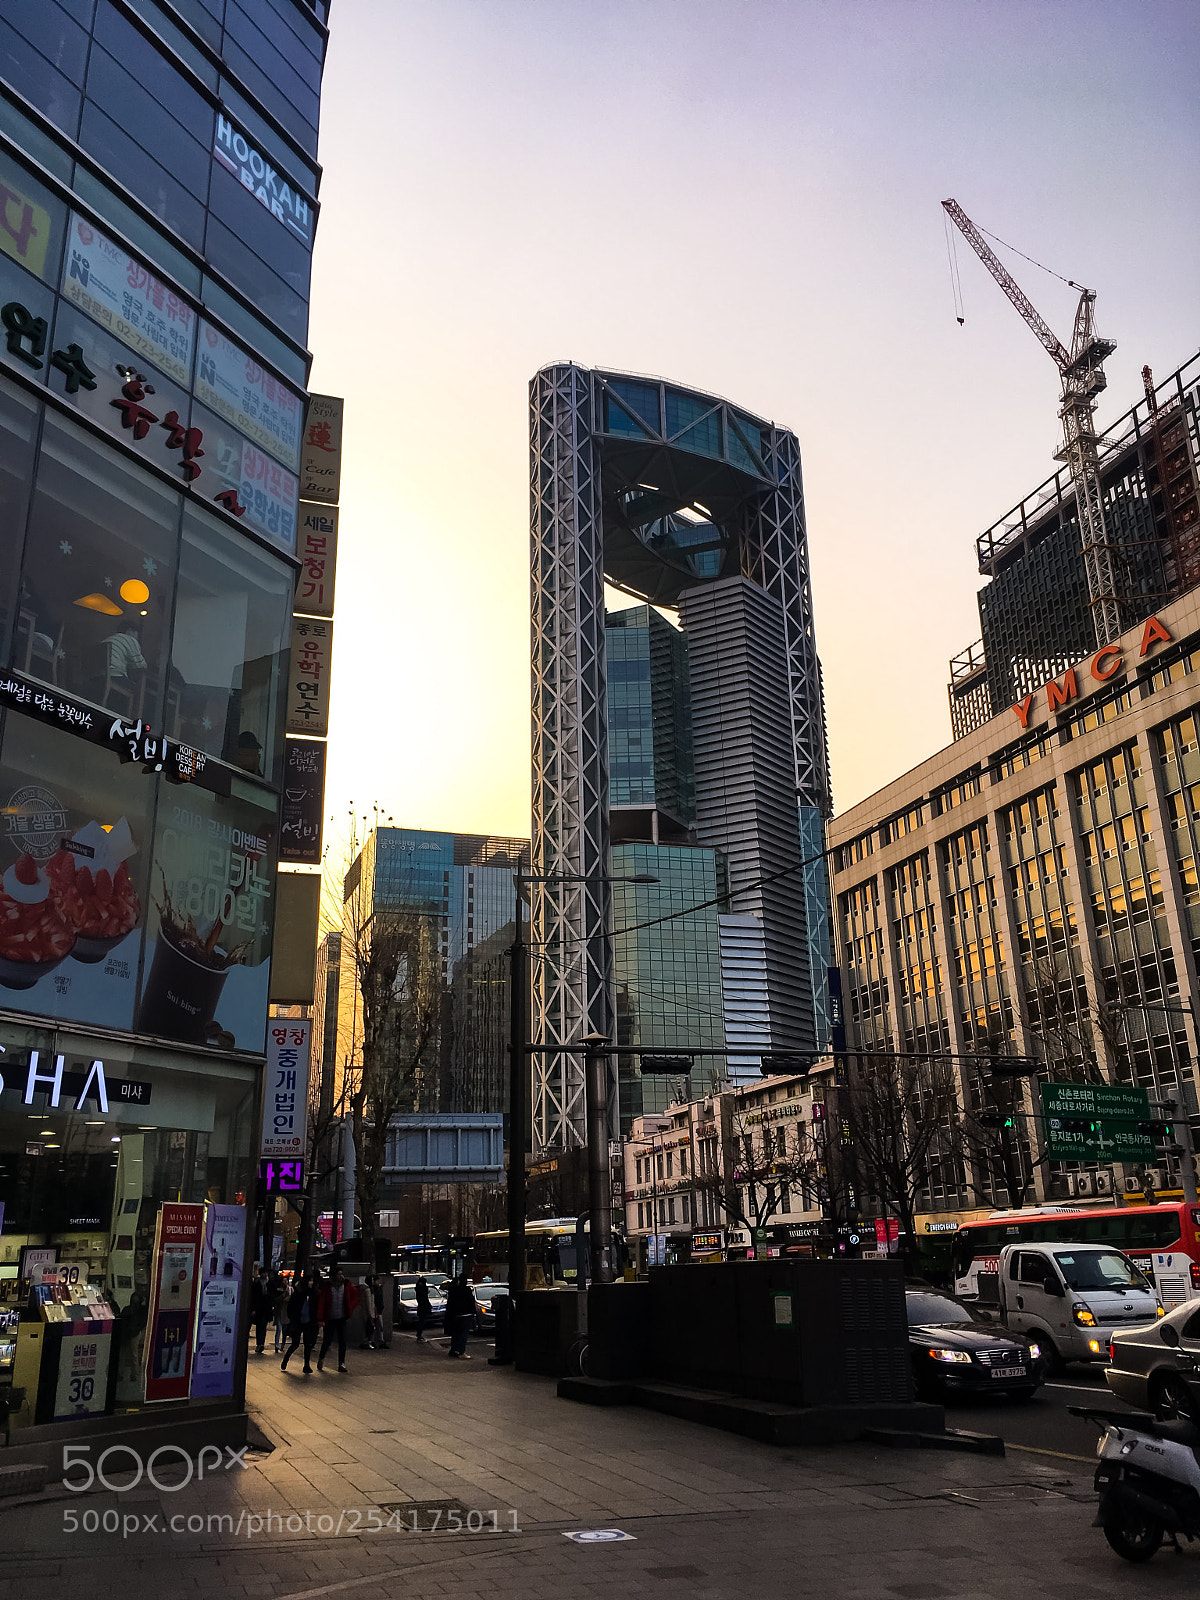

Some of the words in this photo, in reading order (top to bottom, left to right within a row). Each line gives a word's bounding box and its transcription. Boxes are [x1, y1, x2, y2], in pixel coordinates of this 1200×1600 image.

[217, 112, 307, 226] HOOKAH
[241, 166, 285, 226] BAR
[123, 290, 143, 317] 영국
[70, 285, 113, 325] 상담문의
[116, 319, 186, 380] 02-723-2545
[313, 407, 339, 419] Style
[305, 464, 337, 476] Cafe
[305, 482, 335, 495] Bar
[303, 515, 334, 533] 세일
[302, 535, 327, 604] 보청기
[296, 623, 327, 638] 종로
[297, 641, 323, 680] 유학
[1011, 616, 1172, 729] YMCA
[0, 679, 32, 703] 계절을
[34, 693, 56, 711] 담은
[57, 702, 94, 730] 눈꽃빙수
[295, 681, 321, 720] 연수
[109, 718, 168, 772] 설빙
[179, 744, 207, 764] KOREAN
[175, 752, 205, 772] DESSERT
[178, 763, 197, 778] CAFE
[4, 814, 29, 832] 겨울
[32, 812, 67, 831] 생딸기
[173, 806, 202, 831] 2018
[282, 818, 319, 841] 설빙
[53, 975, 72, 985] 생딸기
[271, 1027, 307, 1046] 영창
[0, 1045, 109, 1113] HA
[121, 1084, 143, 1099] 미샤
[273, 1048, 299, 1135] 중개법인
[1057, 1088, 1095, 1102] 신촌로터리
[1096, 1092, 1121, 1102] Sinchon
[1122, 1094, 1143, 1104] Rotary
[1048, 1101, 1096, 1113] 세종대로사거리
[1050, 1130, 1084, 1143] 을지로1가
[1114, 1132, 1152, 1145] 안국동사거리
[259, 1162, 302, 1191] 진
[169, 1213, 197, 1221] MISSHA
[166, 1225, 184, 1234] SPECIAL
[184, 1226, 198, 1235] EVENT
[29, 1252, 51, 1261] GIFT
[164, 1327, 180, 1343] 1+1
